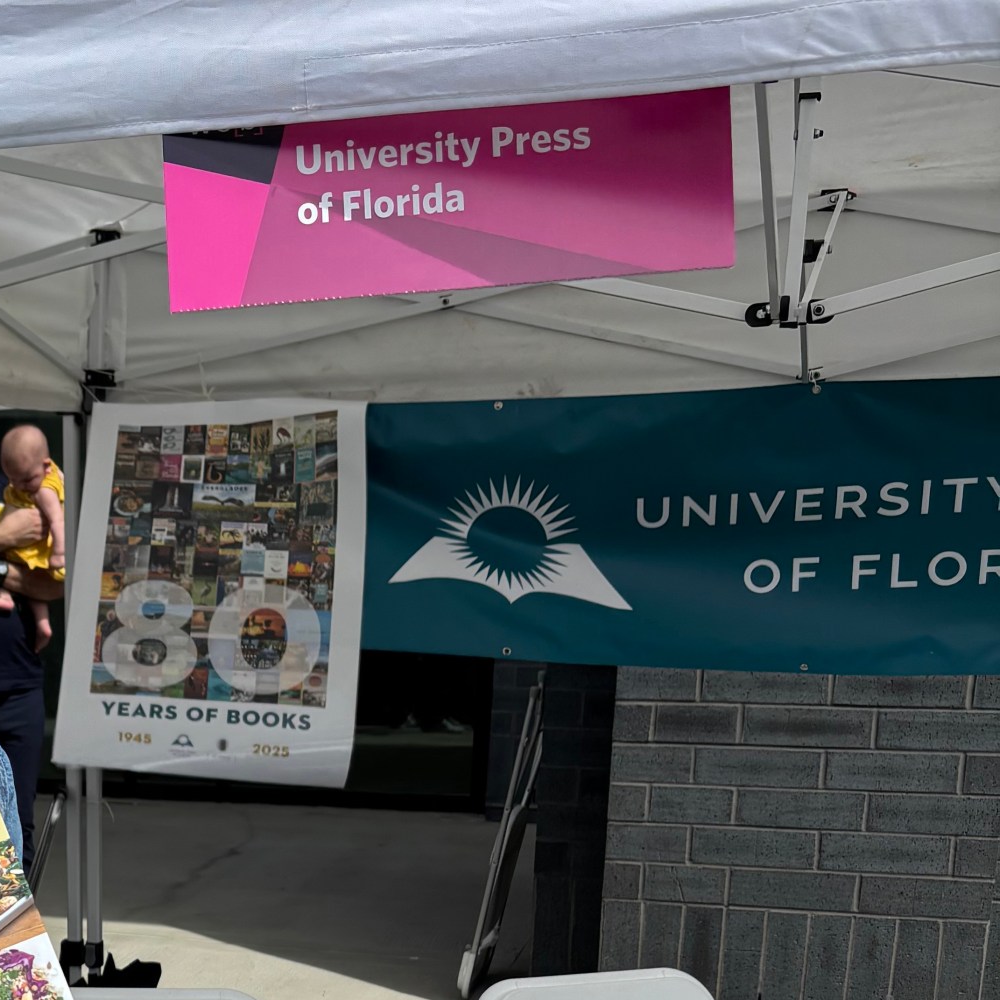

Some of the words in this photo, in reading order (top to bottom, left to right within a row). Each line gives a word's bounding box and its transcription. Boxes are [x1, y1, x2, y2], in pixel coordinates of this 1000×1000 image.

[295, 131, 481, 175] University
[491, 125, 591, 158] Press
[297, 194, 331, 225] of
[343, 182, 465, 221] Florida
[744, 556, 820, 594] OF
[101, 579, 321, 695] 80
[101, 700, 178, 721] YEARS
[186, 706, 219, 723] OF
[226, 710, 312, 731] BOOKS
[118, 731, 152, 745] 1945
[253, 743, 290, 758] 2025
